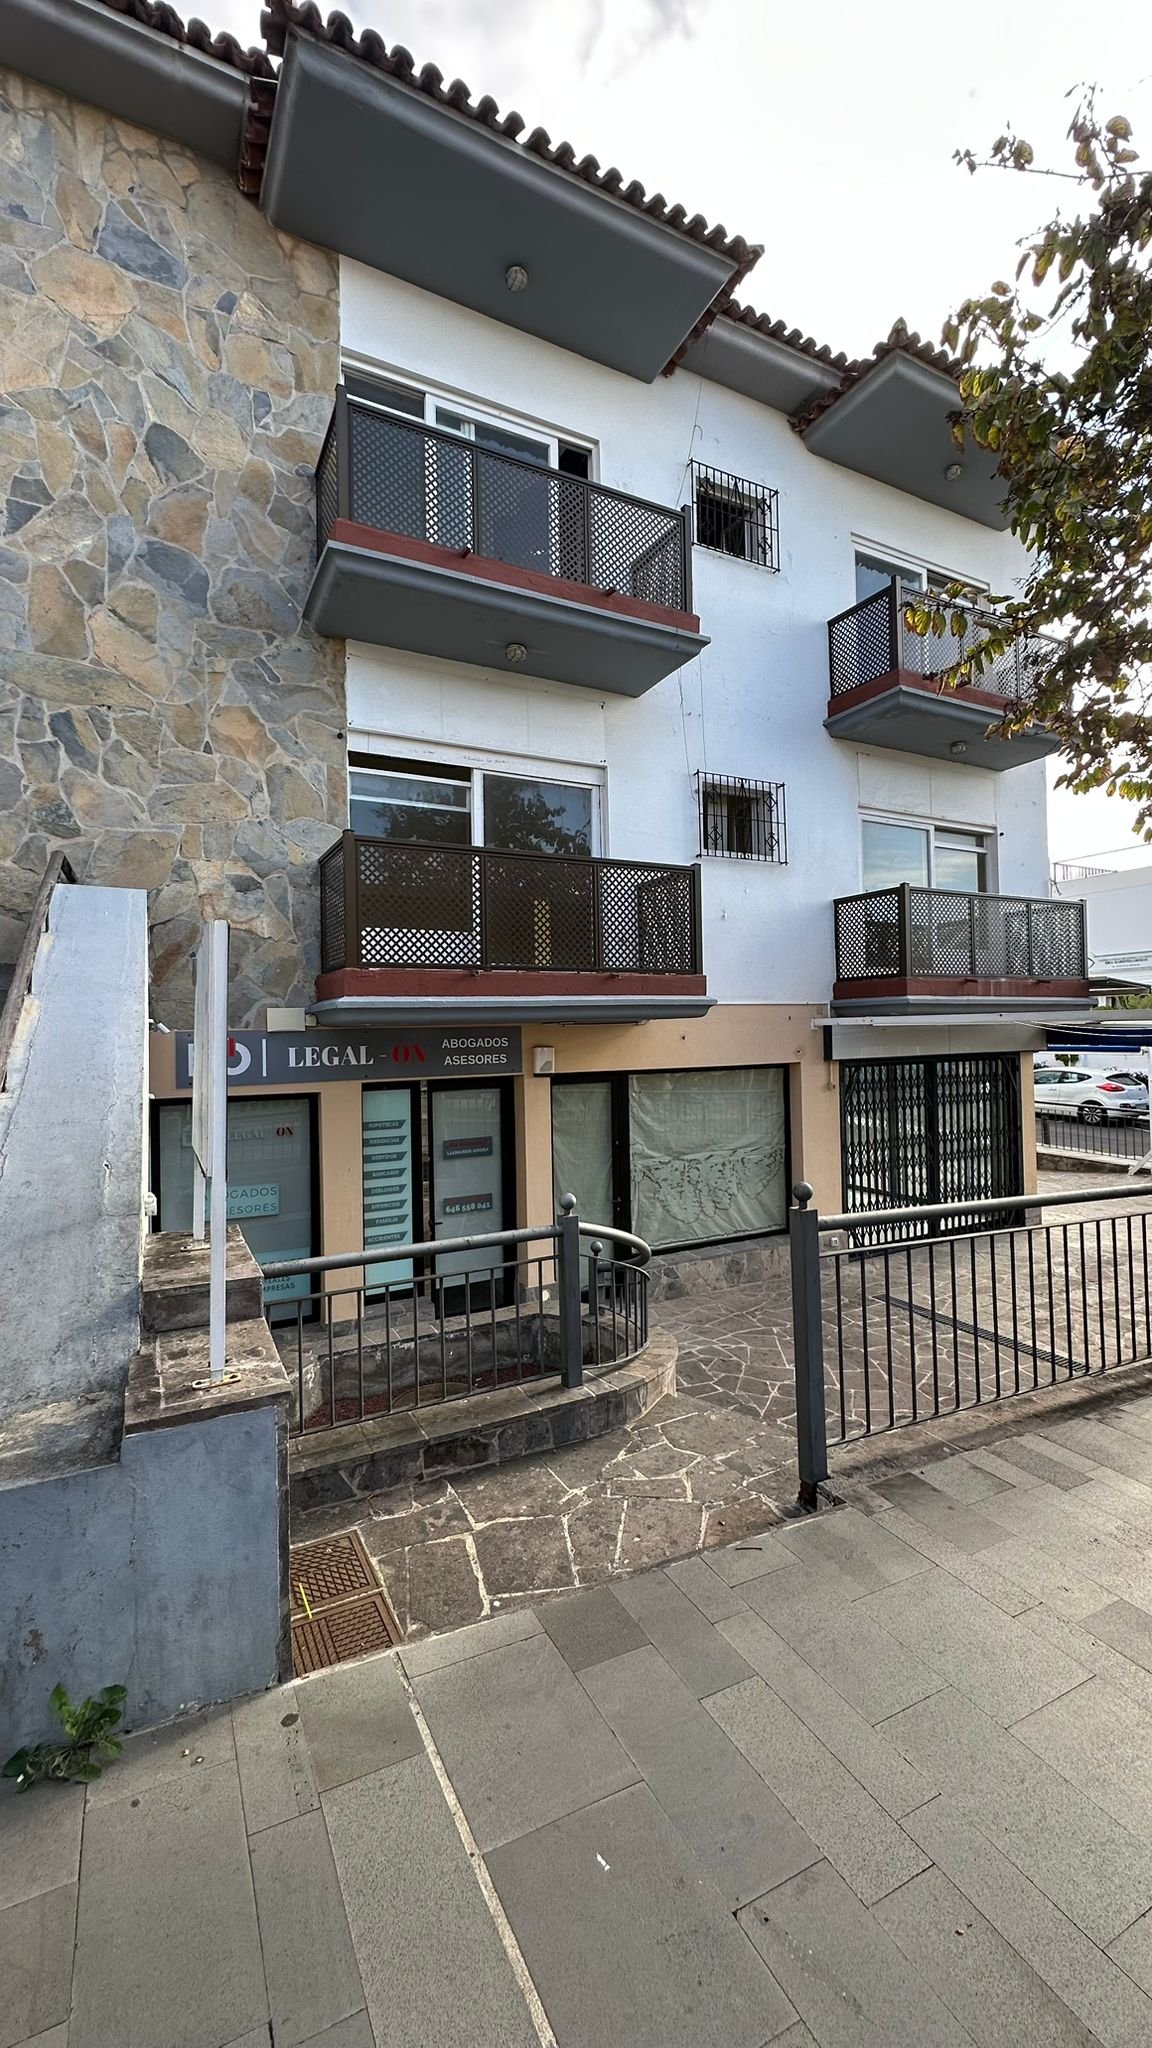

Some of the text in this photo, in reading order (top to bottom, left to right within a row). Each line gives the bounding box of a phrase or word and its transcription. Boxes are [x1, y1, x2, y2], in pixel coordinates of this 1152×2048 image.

[442, 1037, 509, 1049] ABOGADOS
[287, 1045, 375, 1068] LEGAL
[392, 1044, 429, 1064] ON
[444, 1053, 508, 1066] ASESORES
[276, 1126, 294, 1137] ON
[227, 1202, 278, 1215] ESORES
